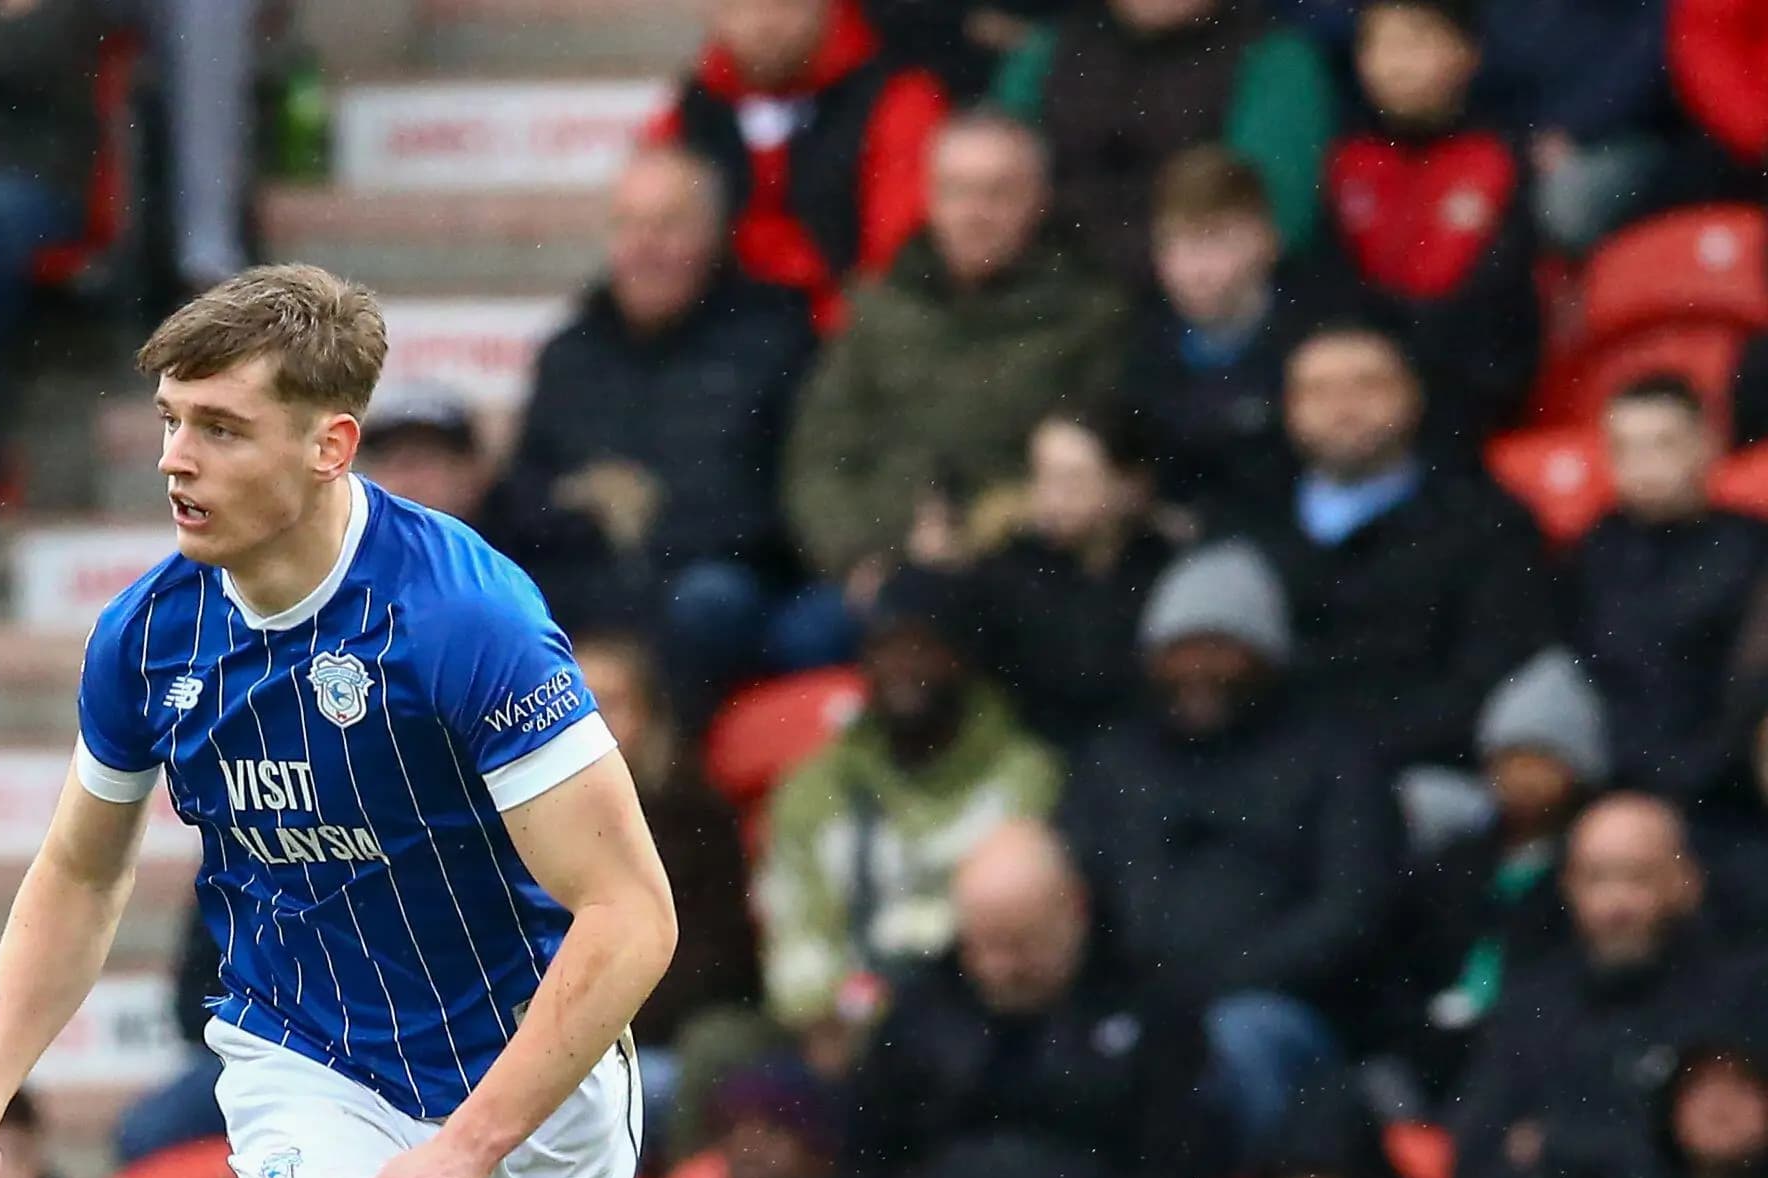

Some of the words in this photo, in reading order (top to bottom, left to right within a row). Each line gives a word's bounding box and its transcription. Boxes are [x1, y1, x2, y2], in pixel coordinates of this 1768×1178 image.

[484, 667, 572, 732] WATCHES
[536, 690, 580, 732] BATH
[219, 759, 314, 812] VISIT
